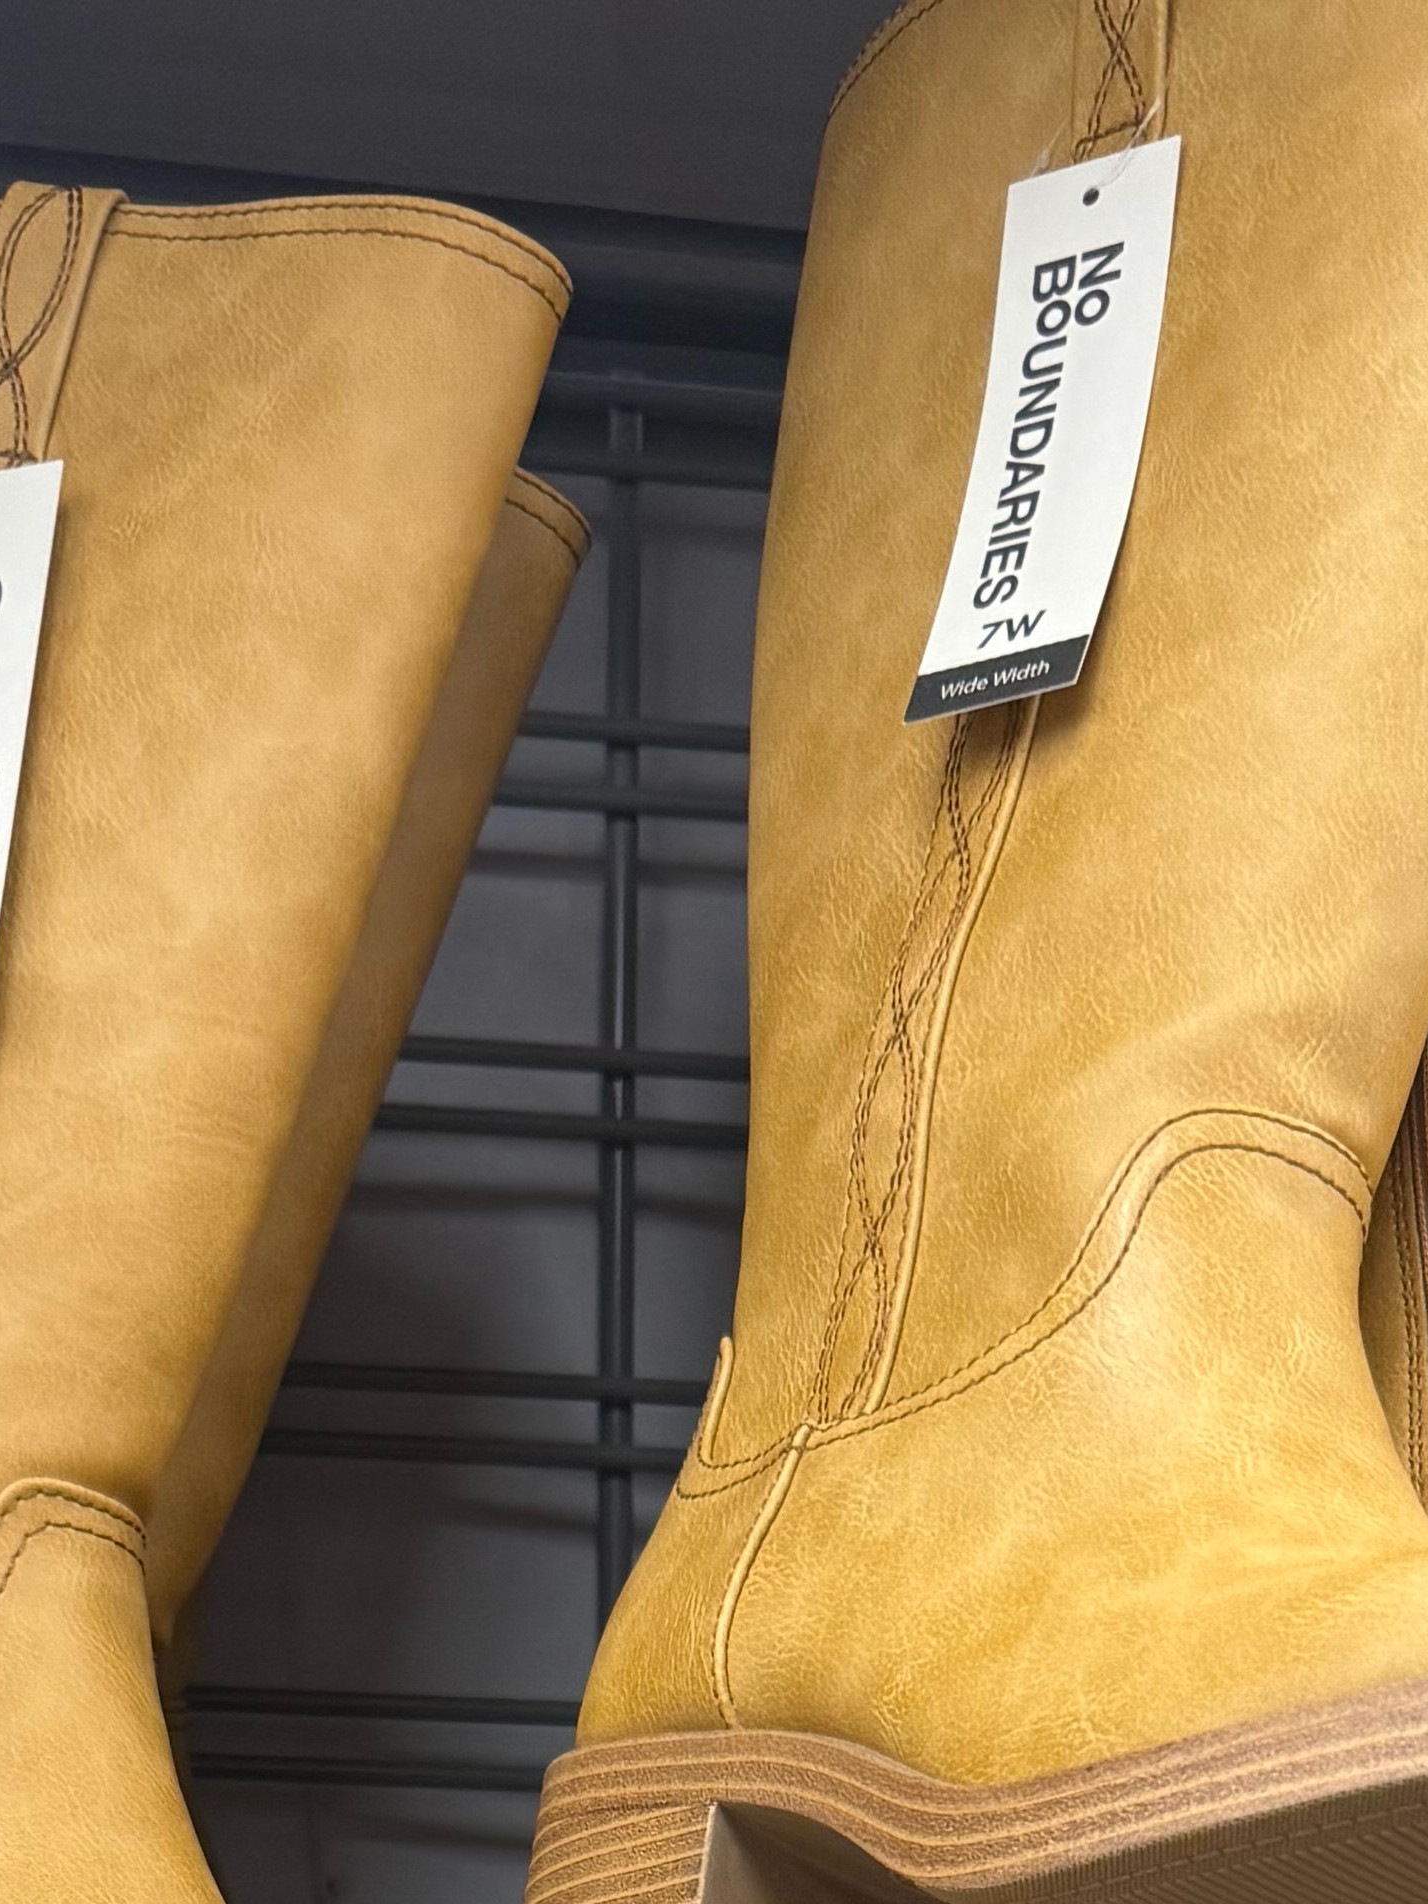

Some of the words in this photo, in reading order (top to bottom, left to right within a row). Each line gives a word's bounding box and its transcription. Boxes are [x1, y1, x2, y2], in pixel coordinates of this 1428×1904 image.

[972, 254, 1077, 610] BOUNDARIES
[977, 608, 1047, 650] 7W
[939, 676, 989, 702] Wide
[992, 658, 1051, 688] Width
